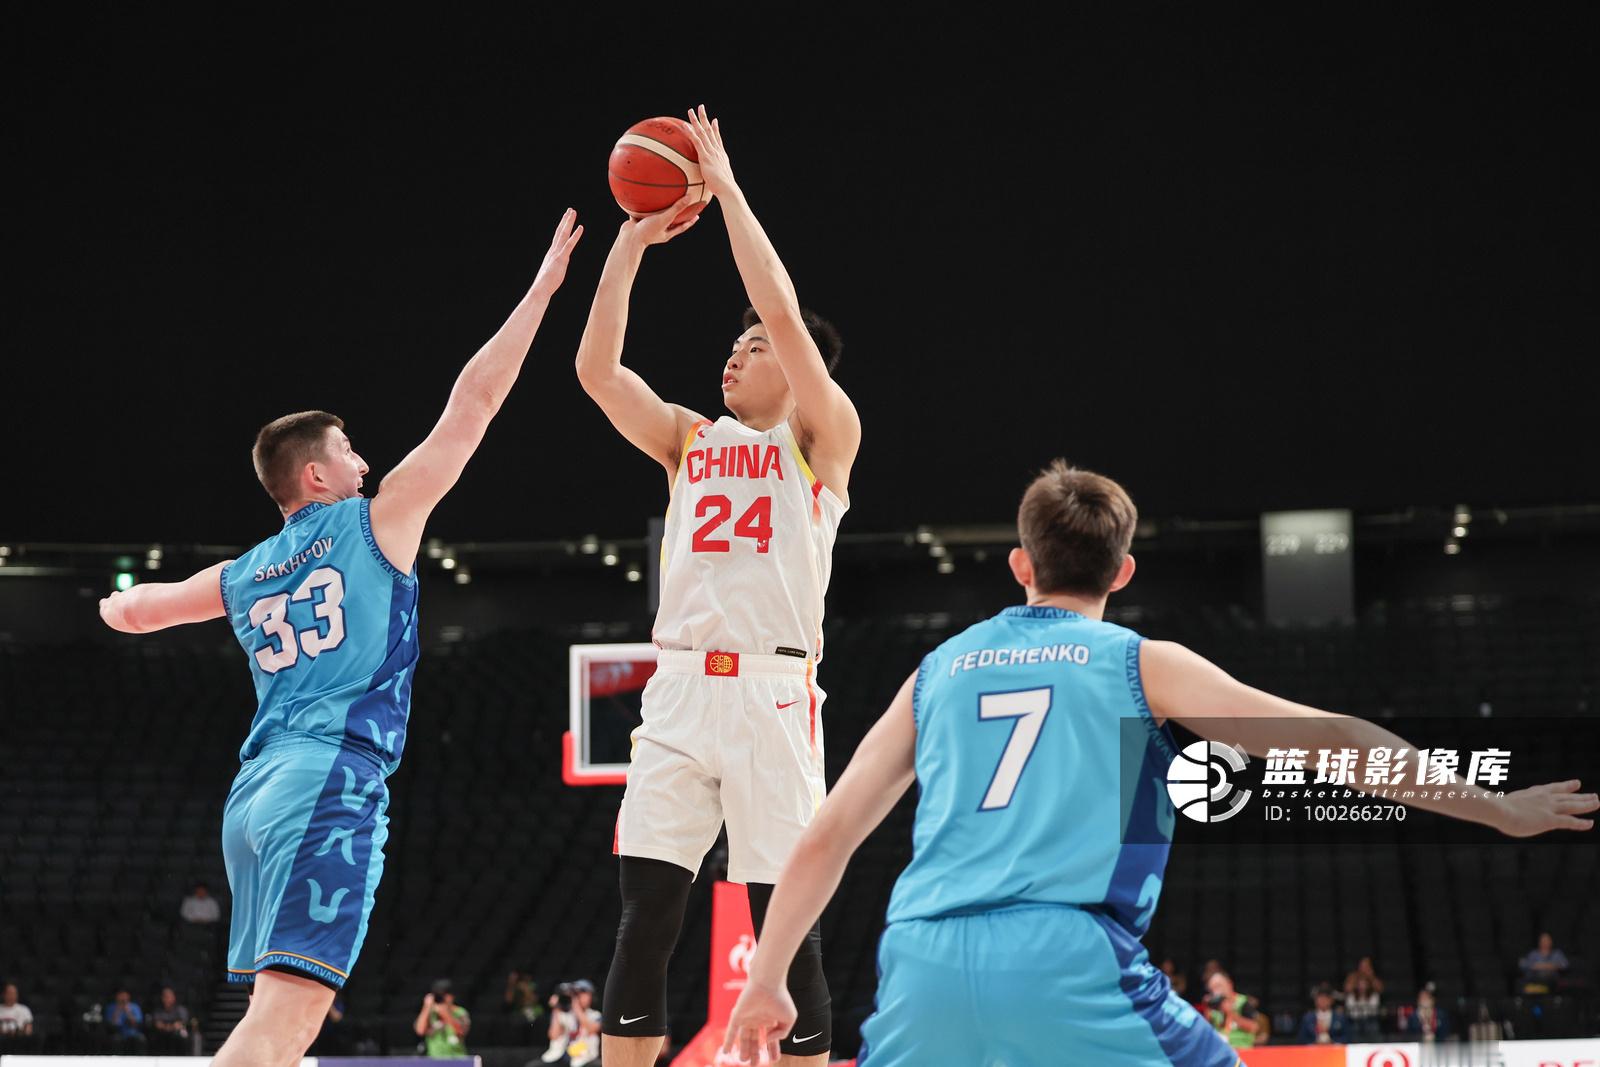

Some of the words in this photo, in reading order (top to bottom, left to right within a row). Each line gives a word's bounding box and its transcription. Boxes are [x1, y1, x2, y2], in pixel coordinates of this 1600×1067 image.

[686, 444, 784, 484] CHINA
[691, 494, 773, 554] 24
[248, 564, 347, 676] 33
[949, 643, 1091, 678] FEDCHENKO
[976, 684, 1054, 812] 7
